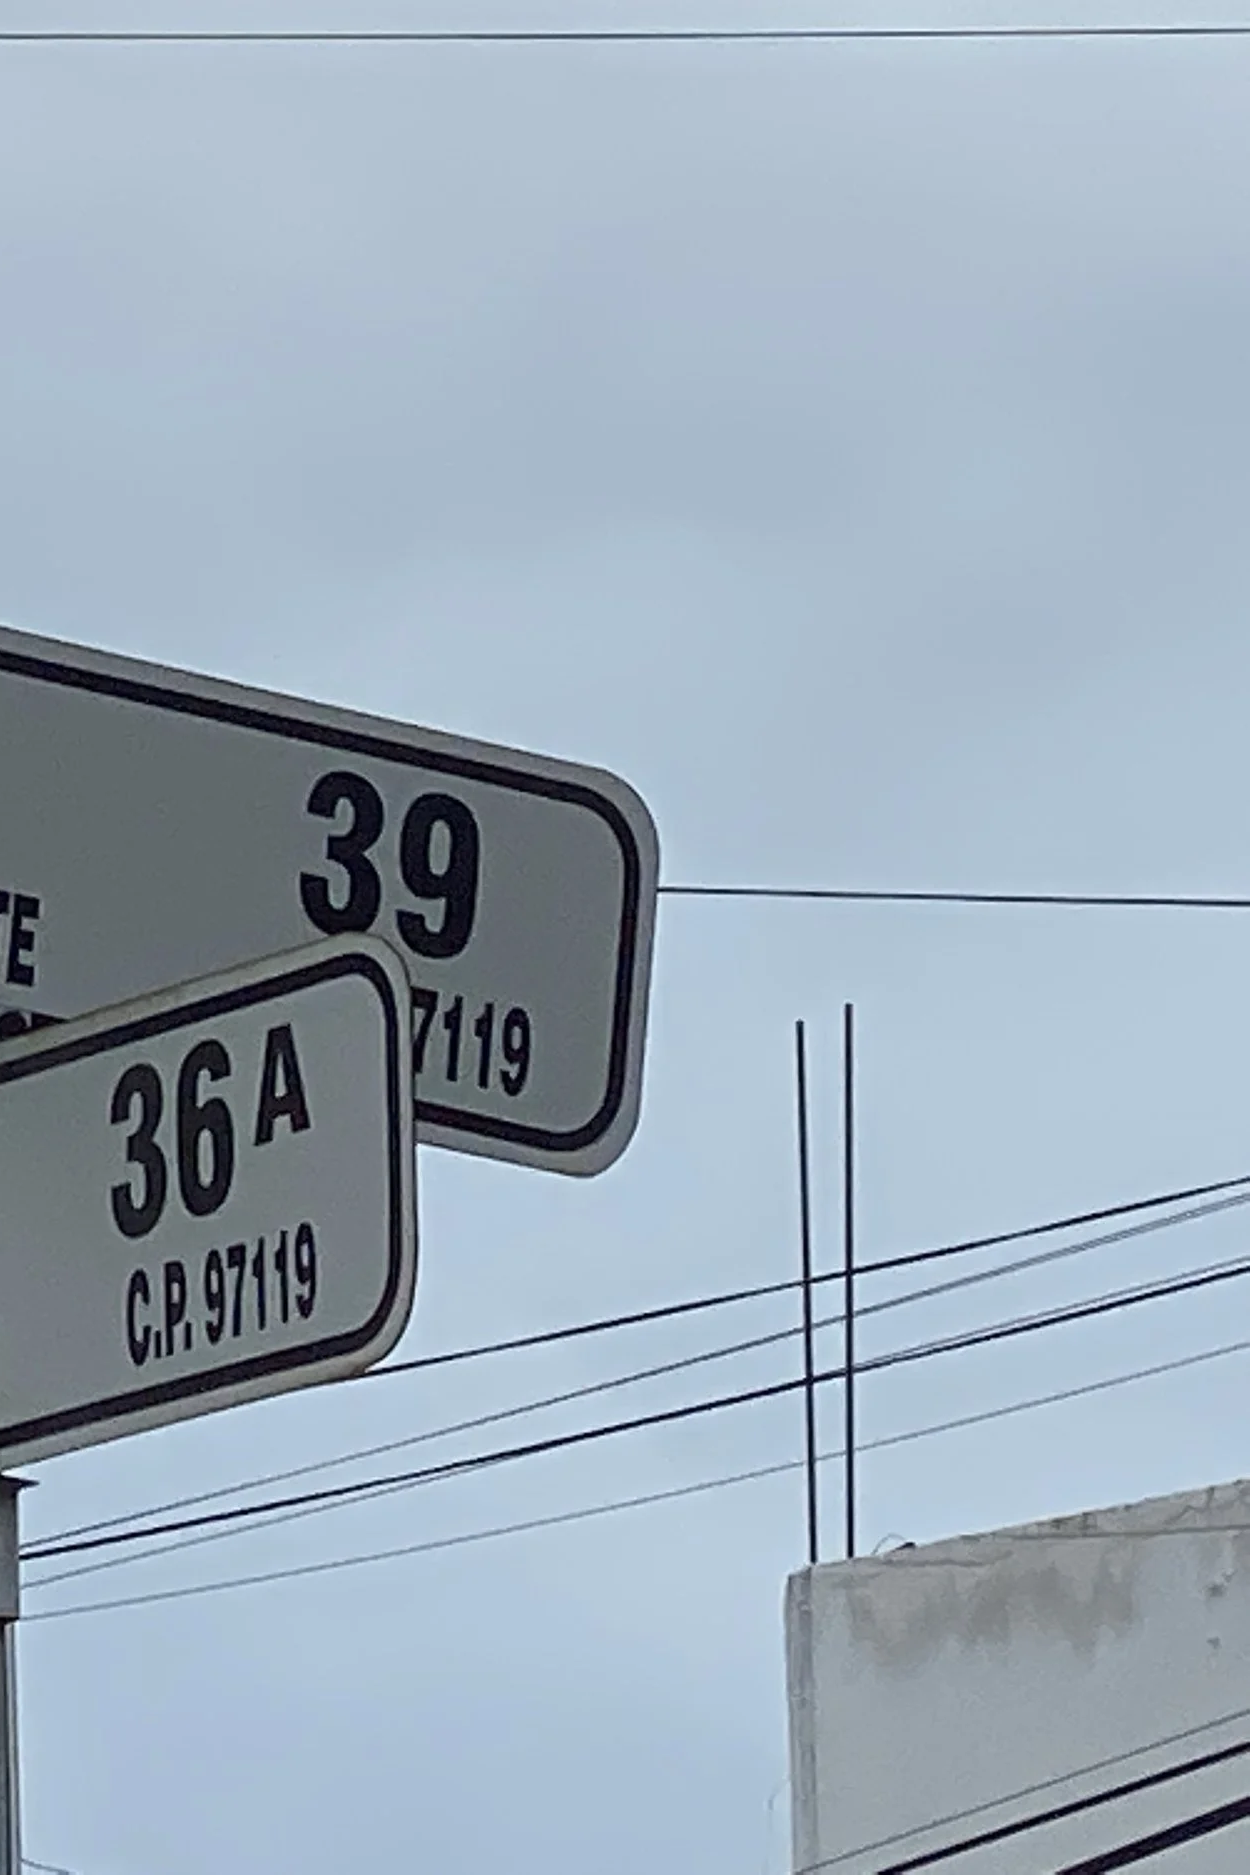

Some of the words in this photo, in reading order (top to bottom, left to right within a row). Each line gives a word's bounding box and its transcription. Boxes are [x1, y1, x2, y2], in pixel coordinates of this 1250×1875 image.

[299, 770, 481, 960] 39
[410, 985, 532, 1097] 7119
[110, 1038, 235, 1240] 36
[252, 1022, 311, 1147] A
[126, 1260, 193, 1367] C.P.
[203, 1222, 317, 1346] 97119
